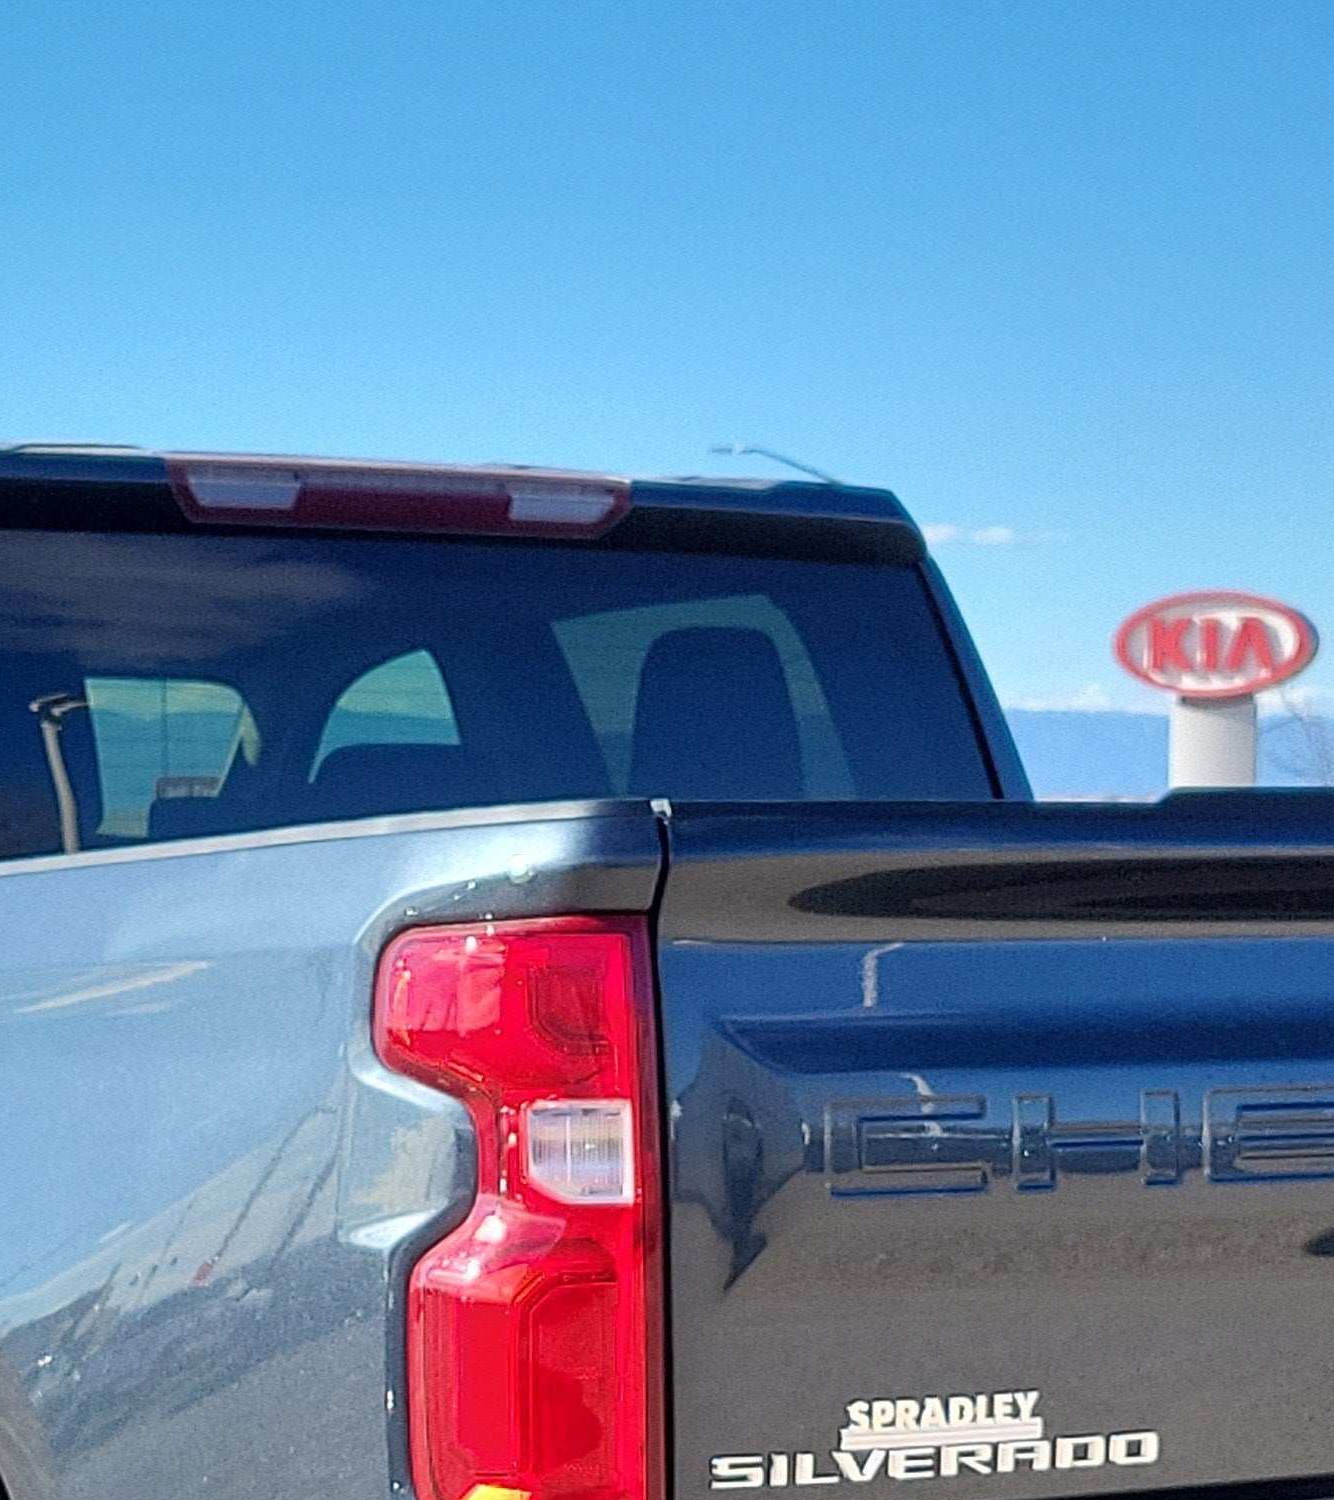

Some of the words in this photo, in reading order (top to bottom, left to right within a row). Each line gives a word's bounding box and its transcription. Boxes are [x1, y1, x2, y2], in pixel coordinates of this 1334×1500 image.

[1147, 615, 1267, 671] KIA
[845, 1390, 1039, 1434] SPRADLEY
[711, 1430, 1160, 1490] SILVERADO
